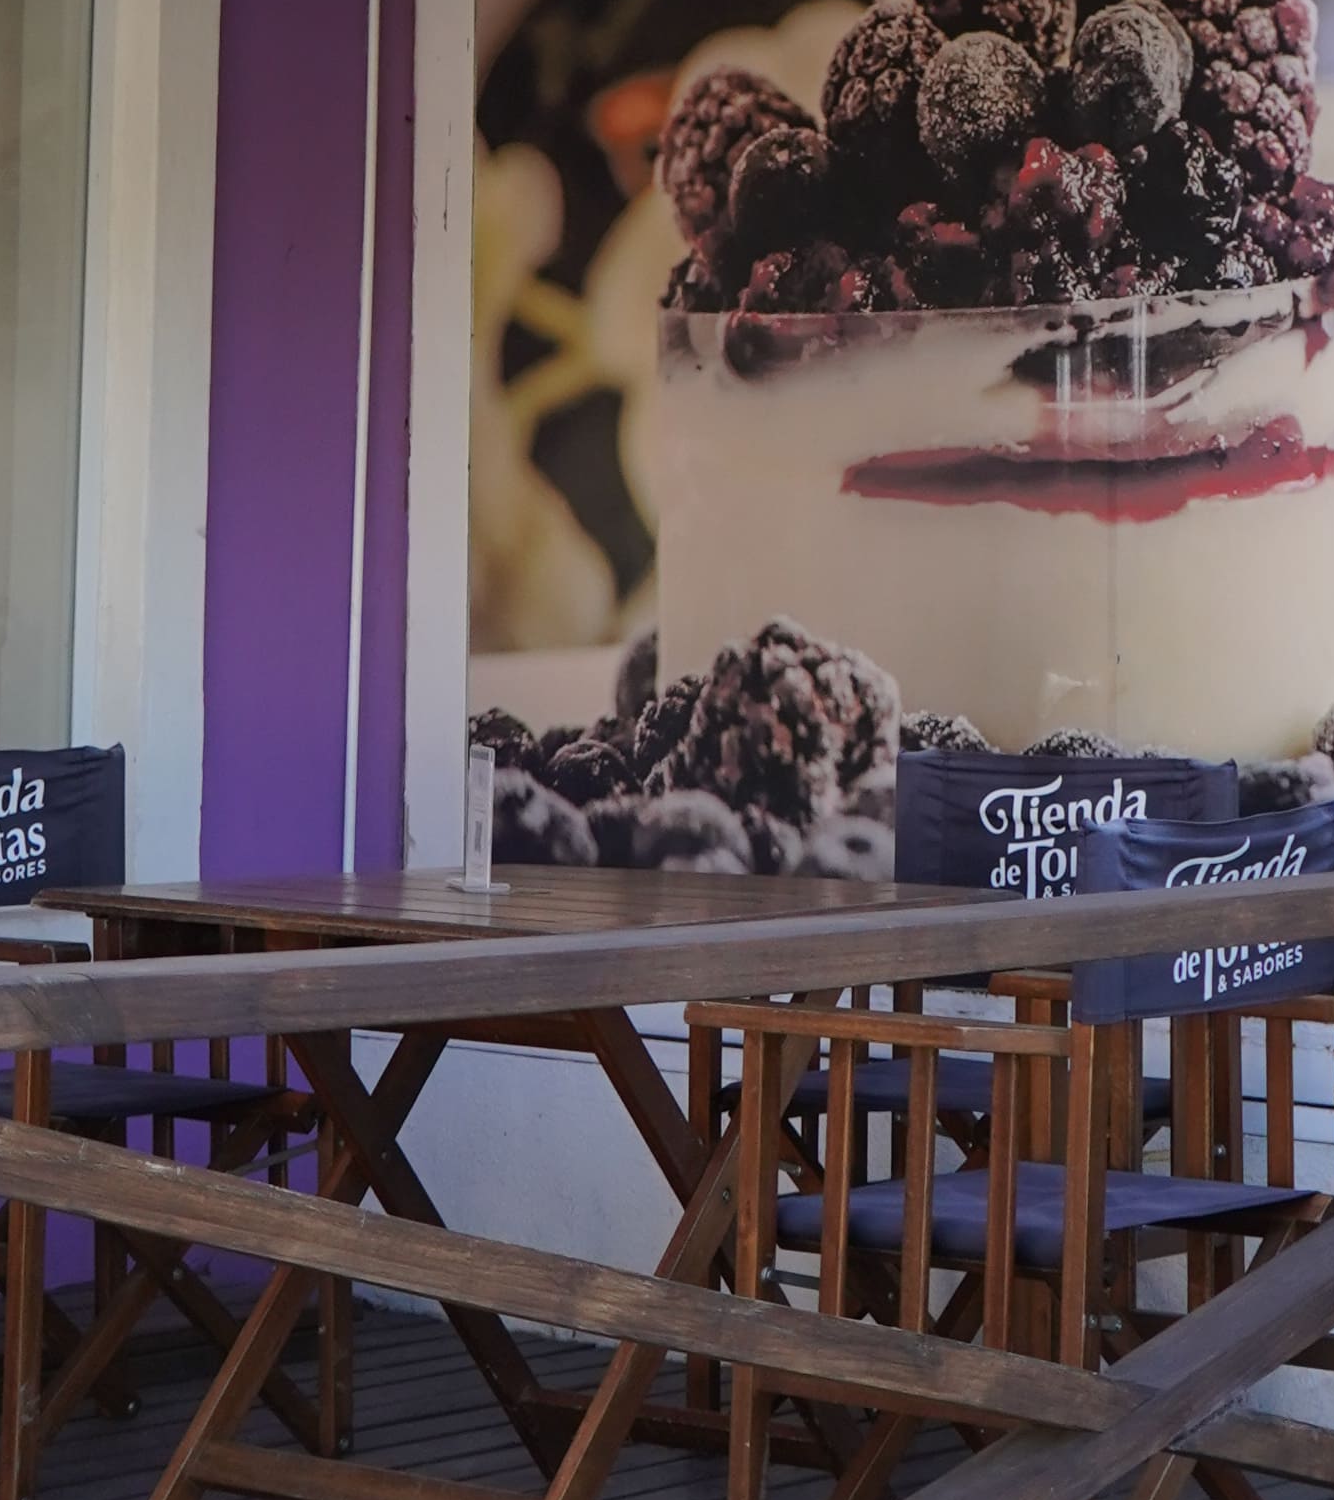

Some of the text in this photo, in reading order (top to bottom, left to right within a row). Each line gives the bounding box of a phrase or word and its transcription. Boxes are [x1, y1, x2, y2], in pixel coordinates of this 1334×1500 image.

[979, 775, 1147, 839] Tienda
[991, 857, 1021, 889] de
[1173, 950, 1200, 984] de
[1218, 974, 1227, 993] &
[1232, 945, 1303, 987] SABORES
